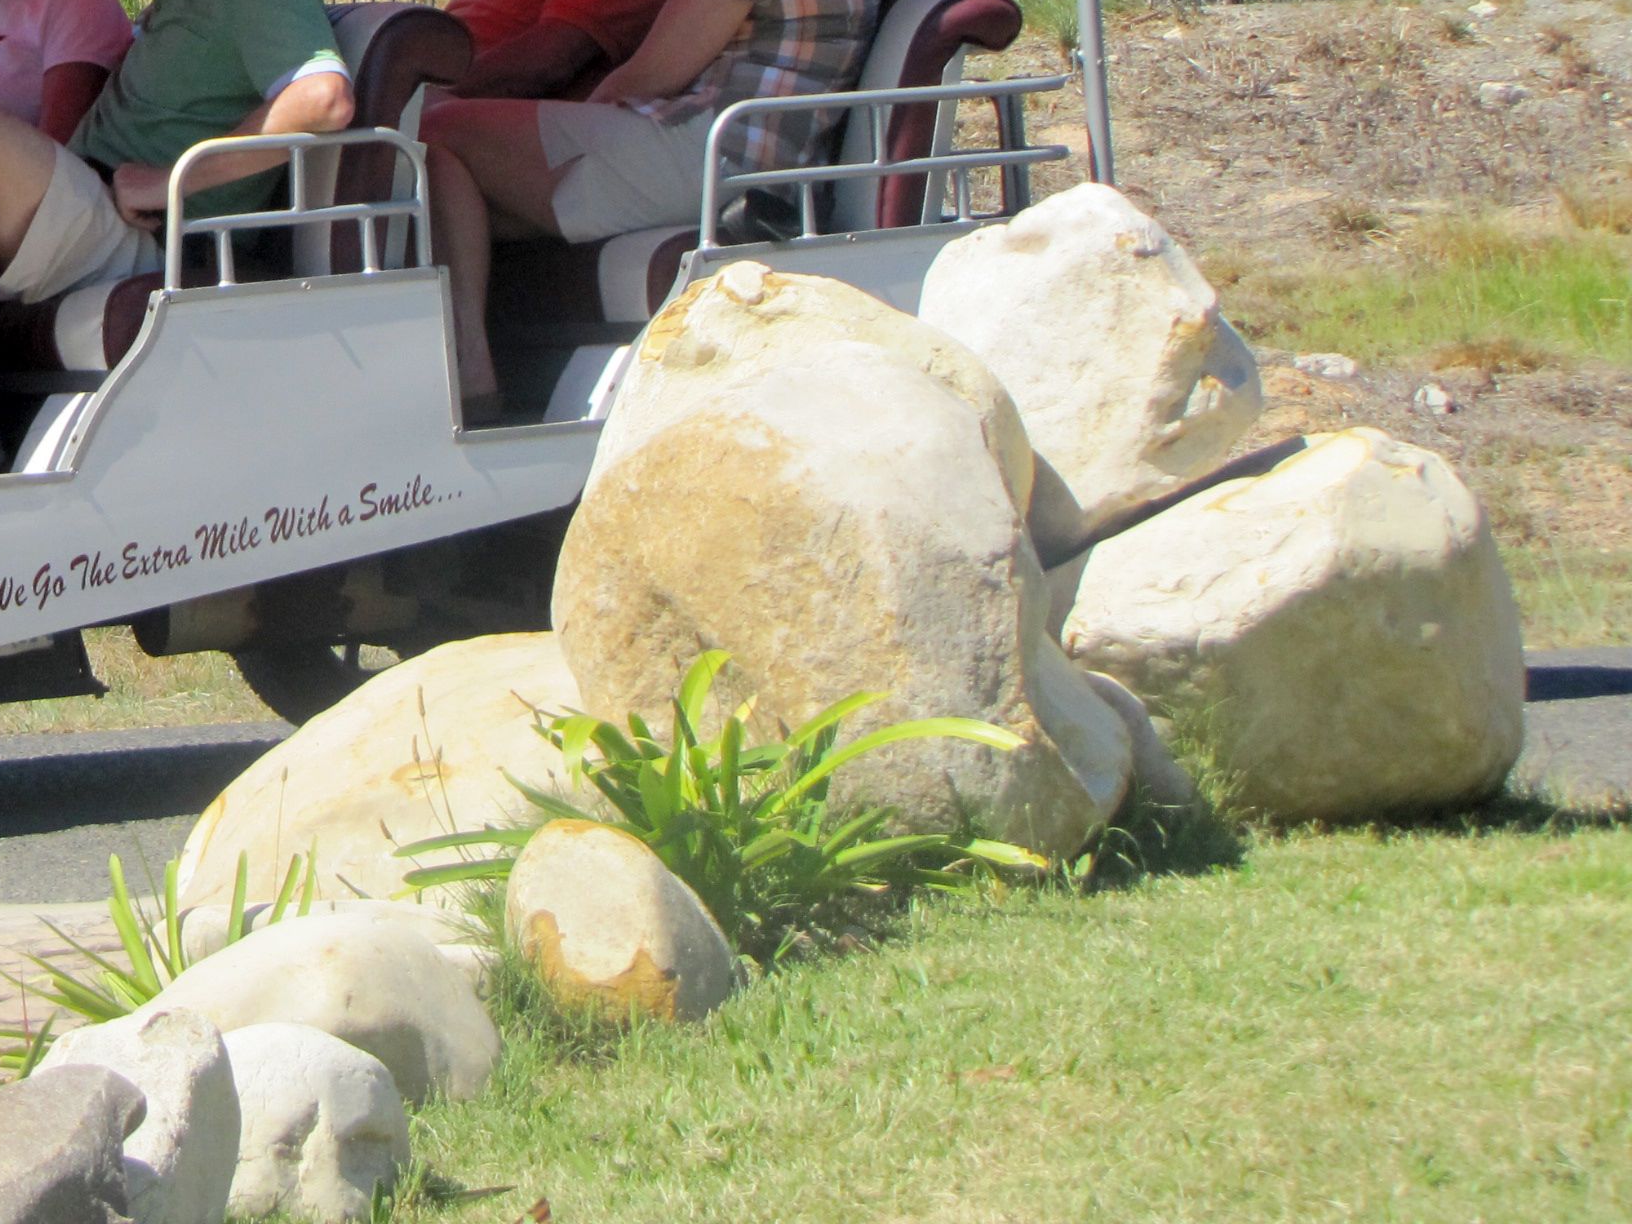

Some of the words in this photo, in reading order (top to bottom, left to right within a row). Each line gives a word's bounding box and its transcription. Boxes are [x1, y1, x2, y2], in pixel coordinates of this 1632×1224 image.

[32, 563, 65, 609] Go
[70, 554, 118, 590] The
[122, 542, 192, 580] Extra
[195, 517, 262, 561] Mile
[265, 495, 333, 544] With
[338, 507, 356, 525] a
[359, 474, 464, 522] Smile...
